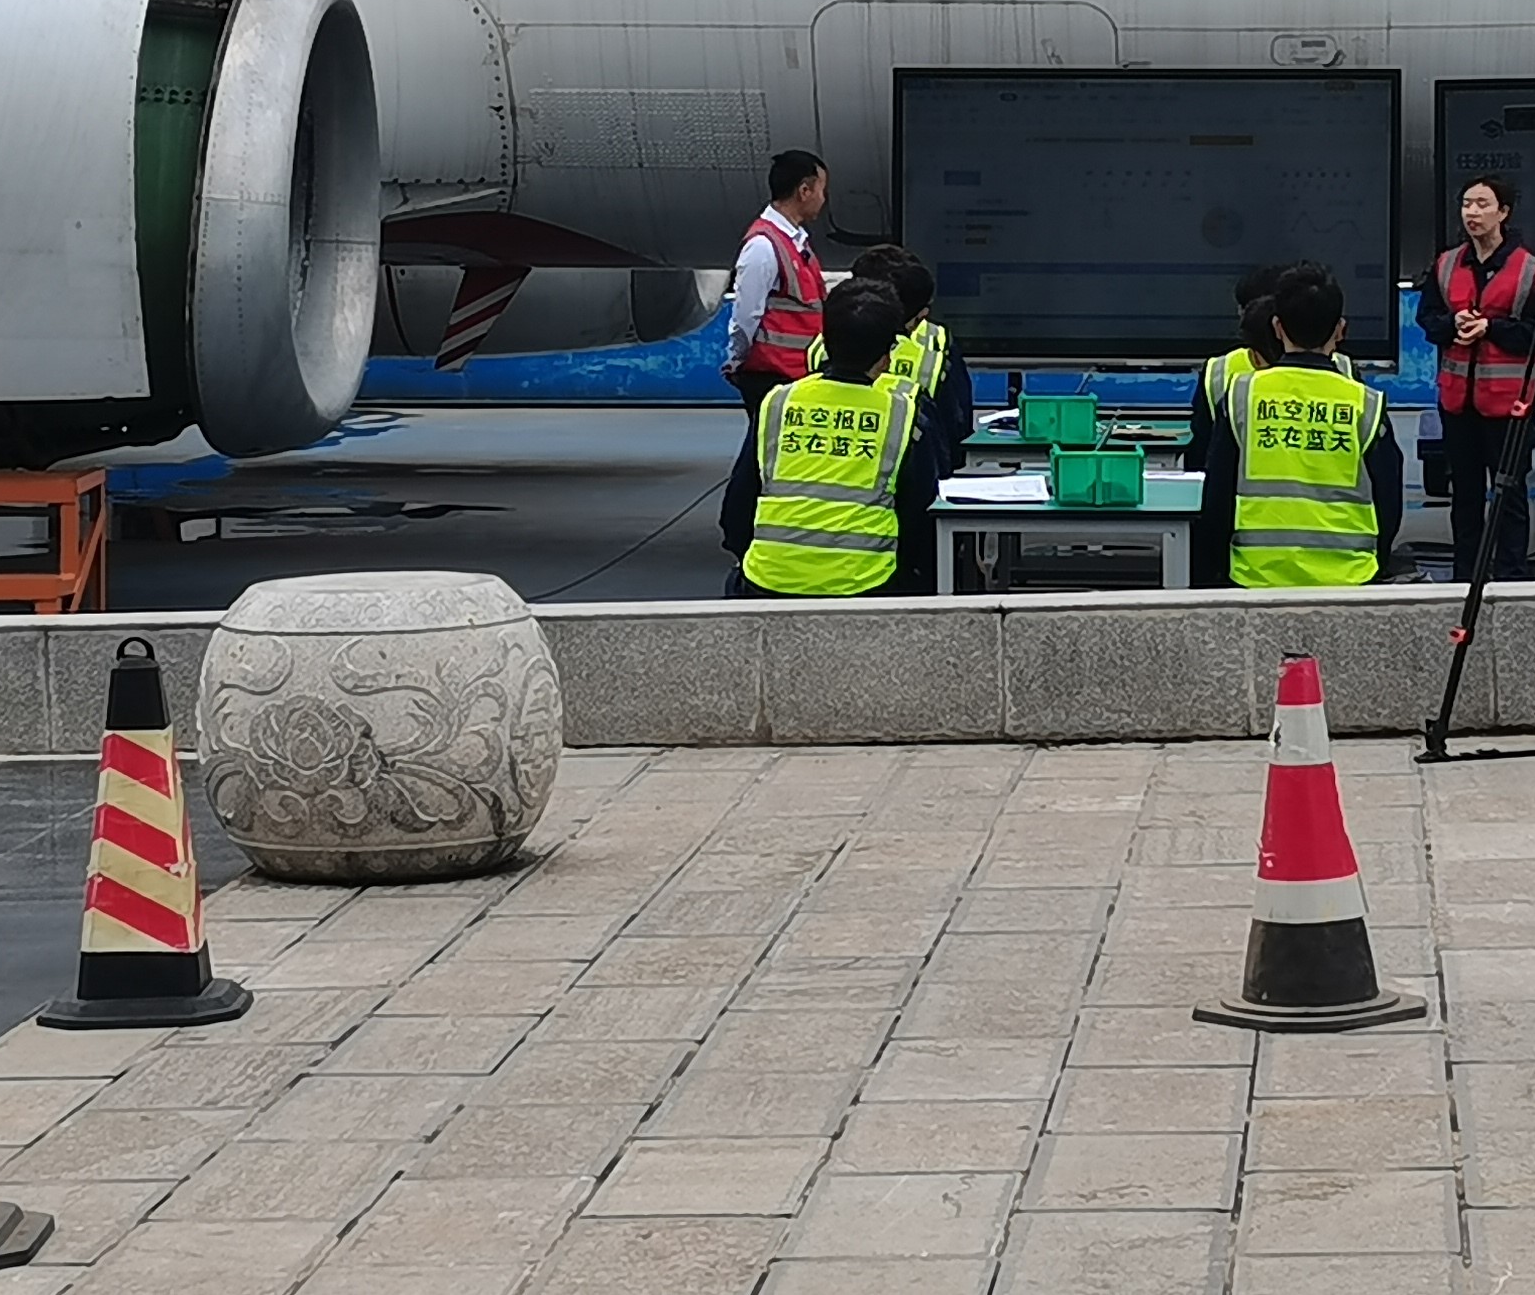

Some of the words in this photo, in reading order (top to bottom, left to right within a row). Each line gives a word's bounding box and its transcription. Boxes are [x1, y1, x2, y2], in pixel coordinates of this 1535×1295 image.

[784, 406, 880, 433] 航空报国
[1257, 399, 1354, 425] 航空报国
[781, 432, 877, 459] 志在蓝天
[1257, 425, 1353, 453] 志在蓝天
